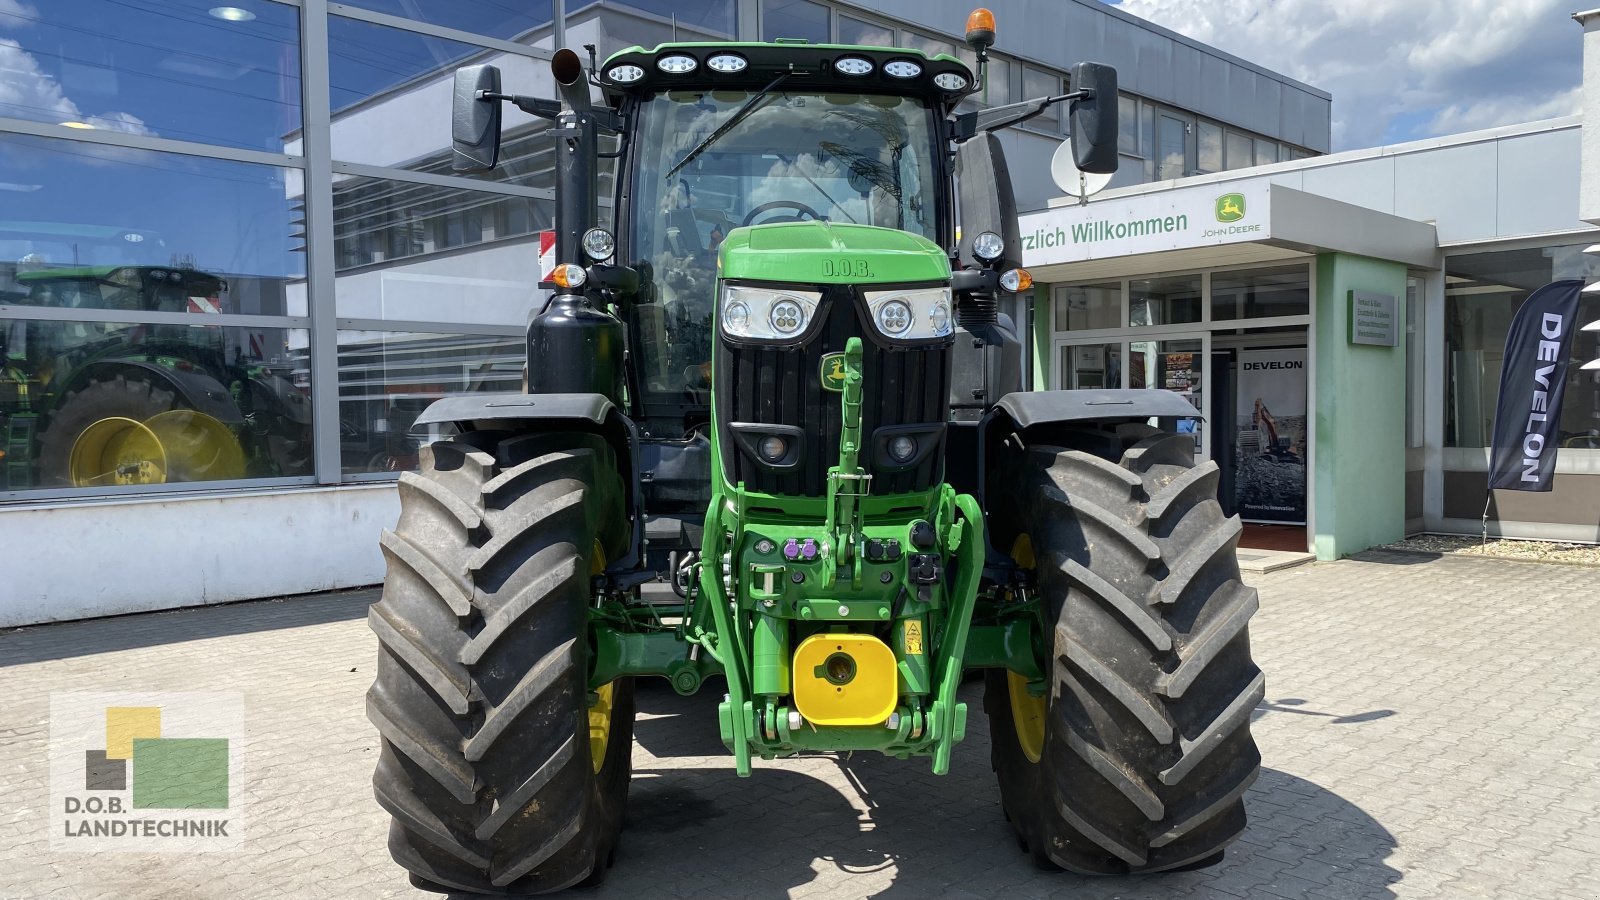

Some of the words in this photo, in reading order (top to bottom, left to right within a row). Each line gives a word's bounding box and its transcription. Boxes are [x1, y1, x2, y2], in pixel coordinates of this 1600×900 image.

[1072, 213, 1188, 244] Willkommen
[1201, 229, 1227, 238] JOHN
[1228, 224, 1261, 235] DEERE
[822, 259, 875, 278] D.O.B.
[1243, 361, 1303, 371] DEVELON
[1520, 312, 1563, 483] DEVELON
